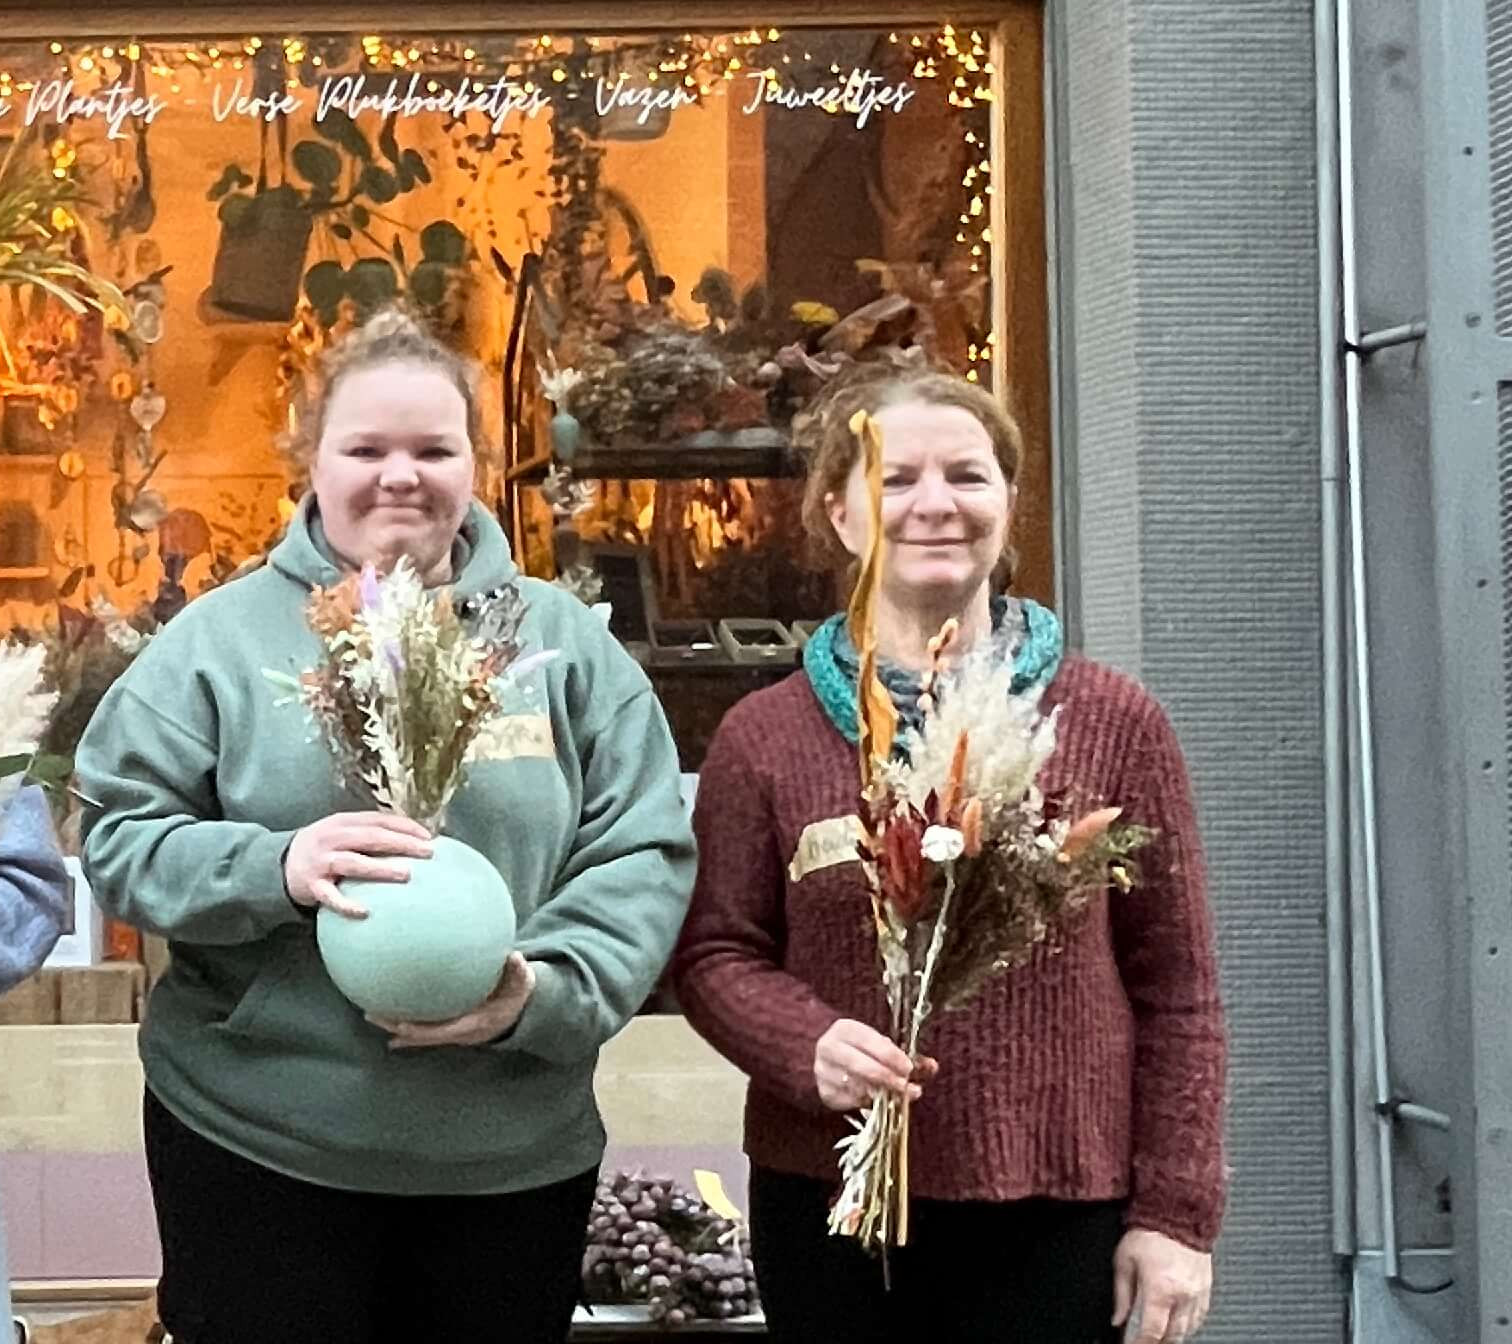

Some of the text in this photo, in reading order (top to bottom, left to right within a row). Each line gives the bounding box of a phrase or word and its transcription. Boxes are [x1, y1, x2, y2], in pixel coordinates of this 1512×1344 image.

[24, 79, 167, 140] Plantjes
[212, 79, 303, 122] Verse
[316, 72, 551, 134] Plukboeketjes
[595, 76, 698, 125] Vazen
[742, 67, 915, 129] Juweeltjes
